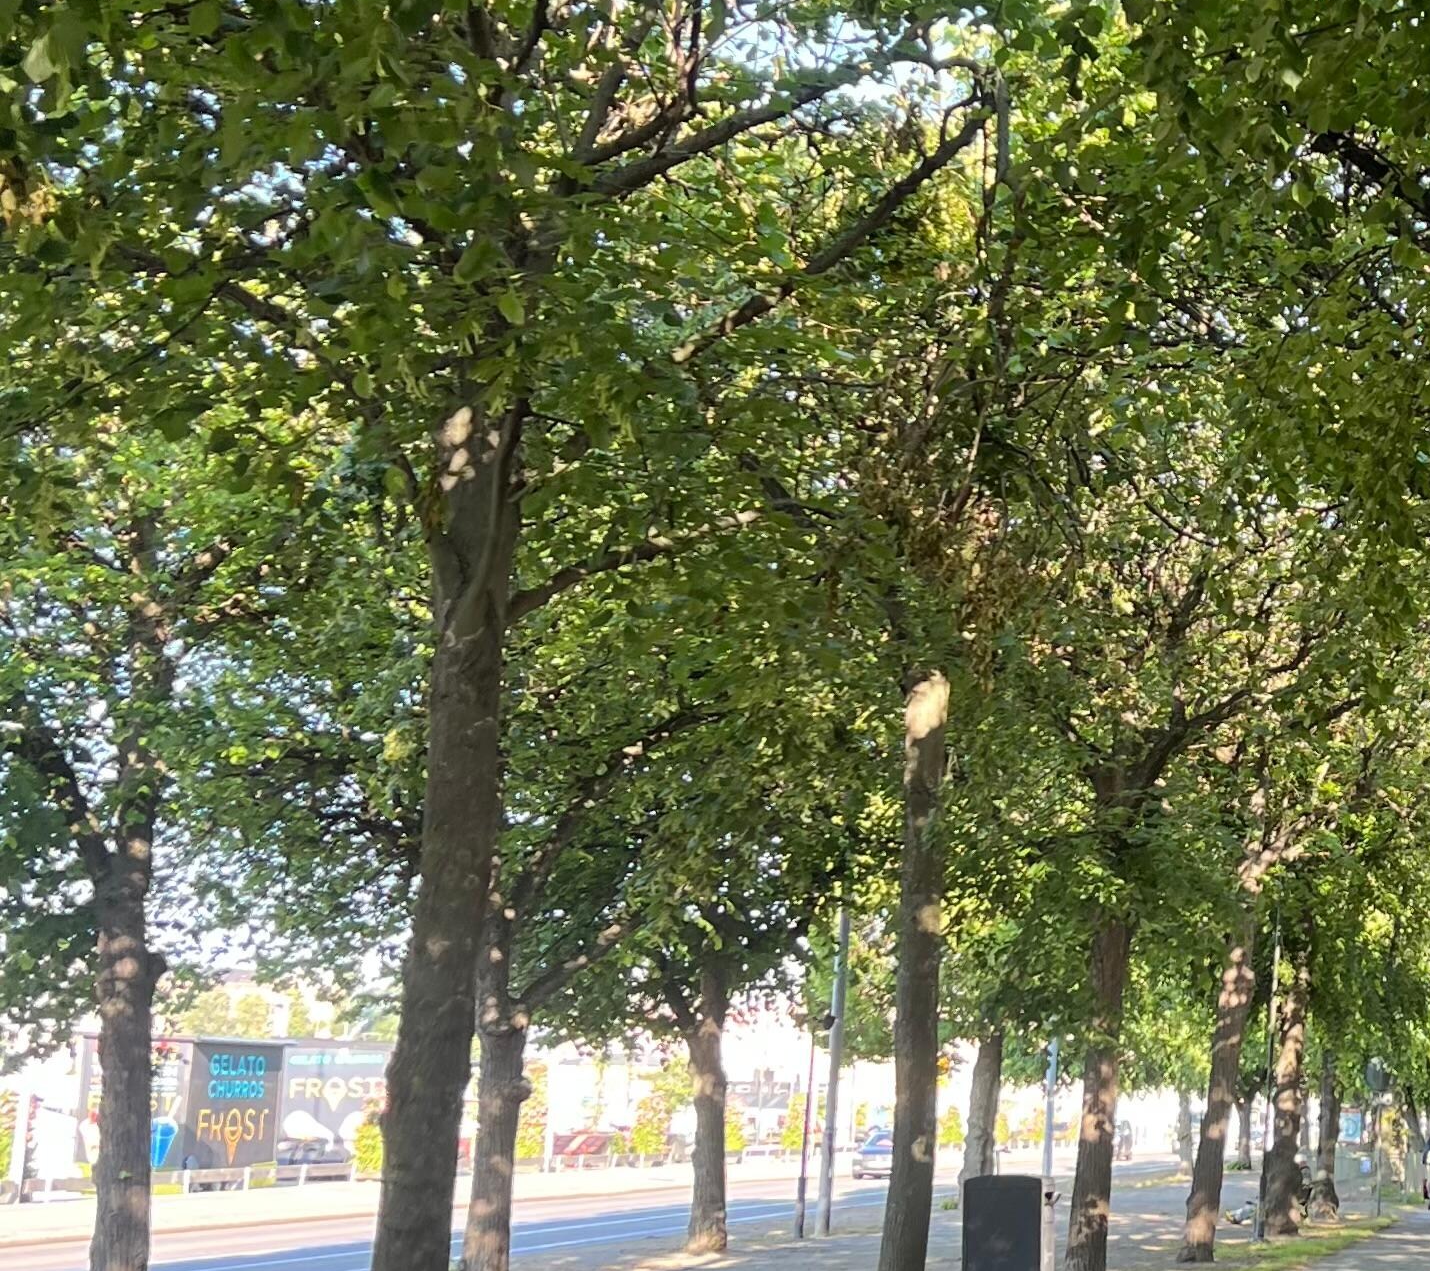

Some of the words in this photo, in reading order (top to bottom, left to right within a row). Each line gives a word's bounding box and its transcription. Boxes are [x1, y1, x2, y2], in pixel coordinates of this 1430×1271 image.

[209, 1053, 266, 1076] GELATO
[207, 1079, 265, 1099] CHURROS
[289, 1077, 385, 1103] FROST
